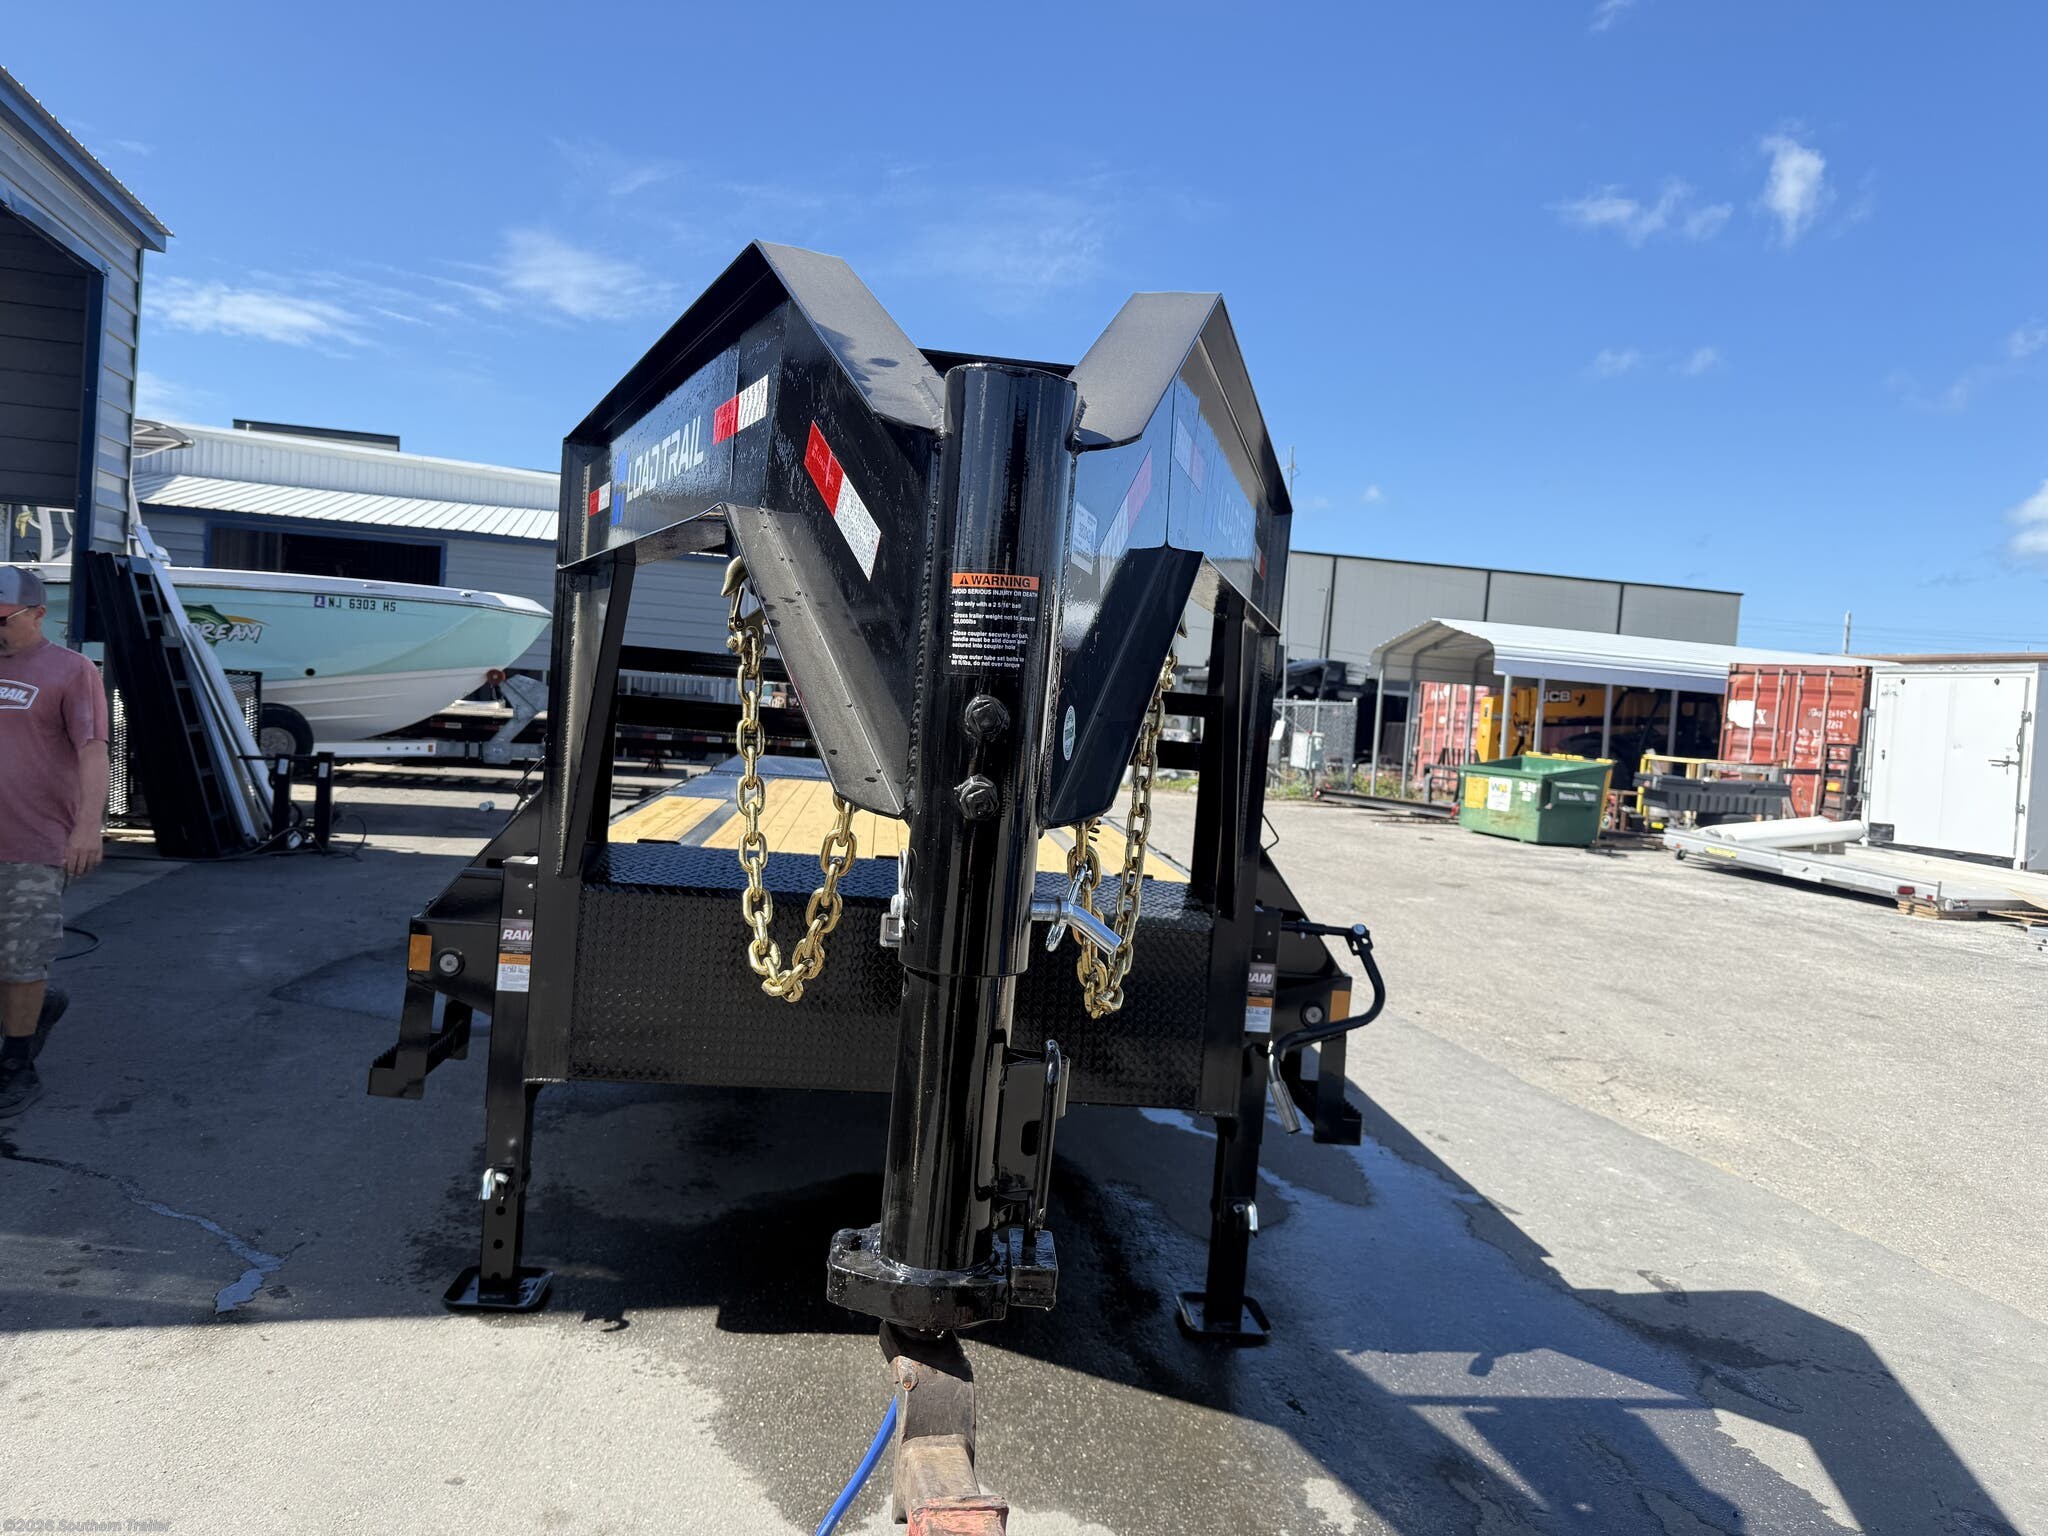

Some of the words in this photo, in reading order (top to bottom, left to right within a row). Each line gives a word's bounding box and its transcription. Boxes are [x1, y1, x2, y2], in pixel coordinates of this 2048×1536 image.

[971, 576, 1031, 588] WARNING
[328, 597, 342, 608] NJ
[349, 598, 376, 611] 6303
[383, 601, 397, 612] HS
